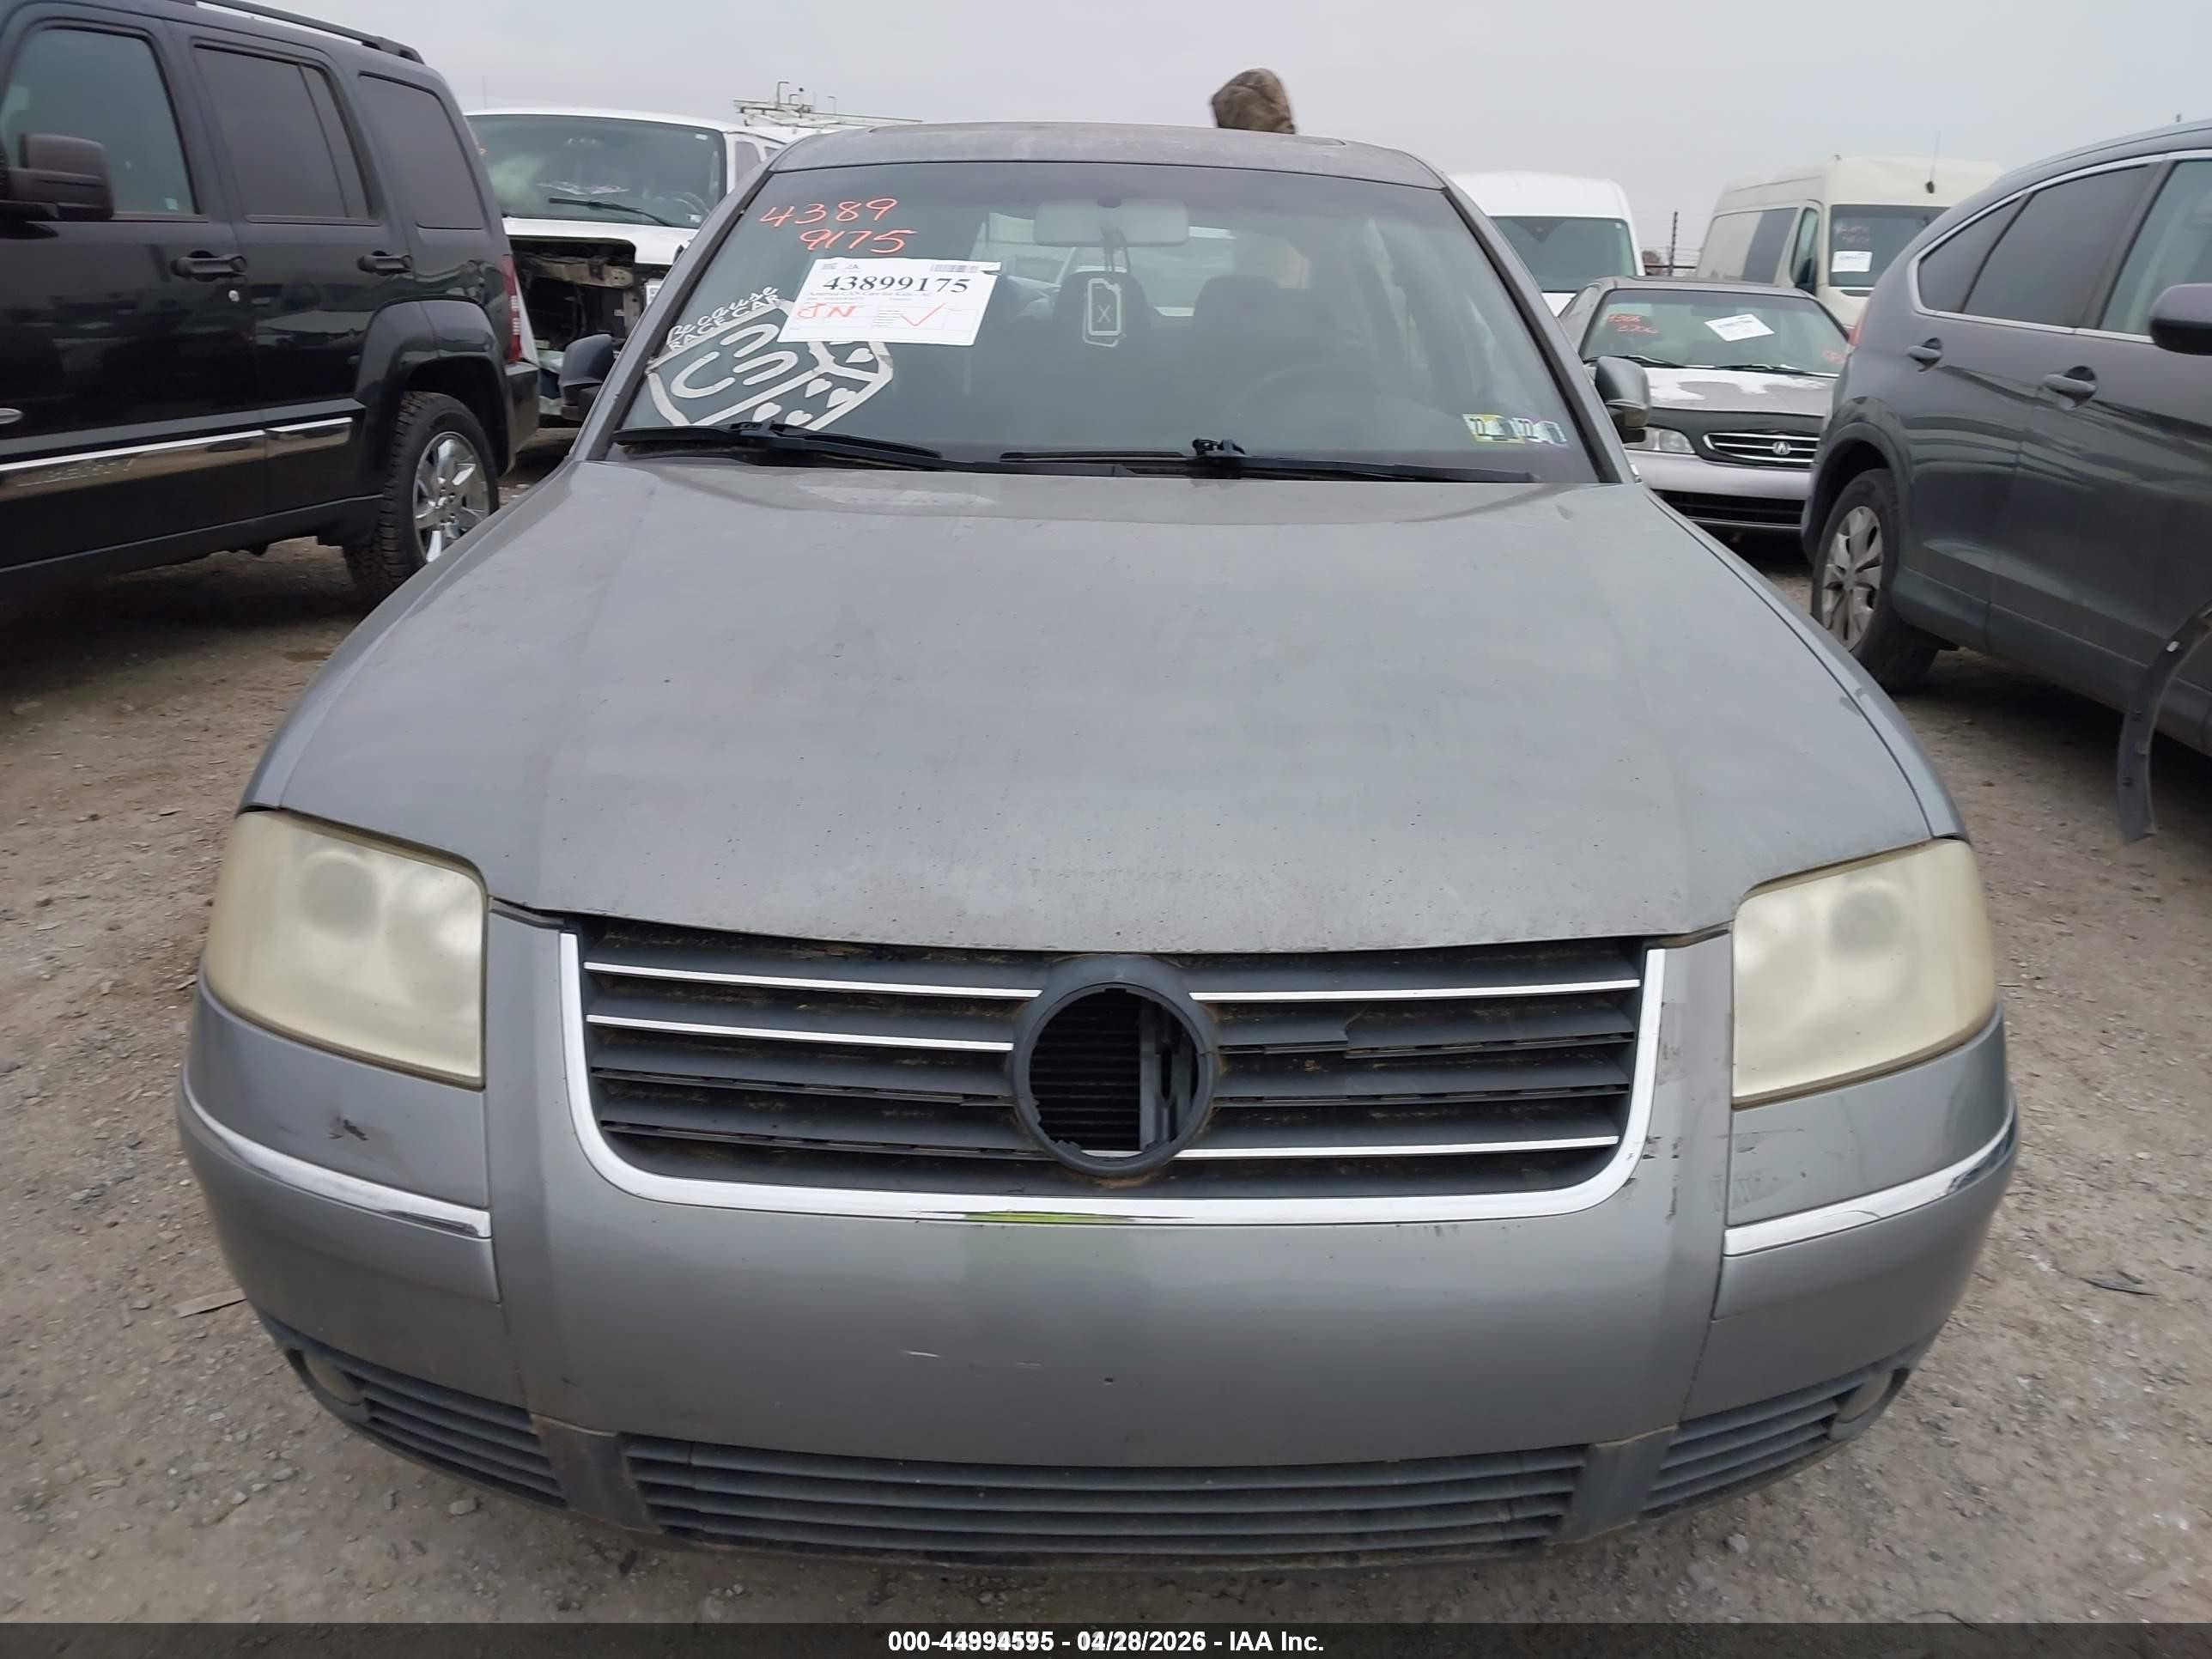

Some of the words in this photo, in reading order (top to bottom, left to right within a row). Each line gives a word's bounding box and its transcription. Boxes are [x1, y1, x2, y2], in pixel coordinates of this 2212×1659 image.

[759, 198, 899, 227] 4389
[799, 228, 918, 253] 9175
[823, 275, 971, 294] 43899175
[669, 316, 731, 350] RACE
[732, 295, 781, 319] CAR
